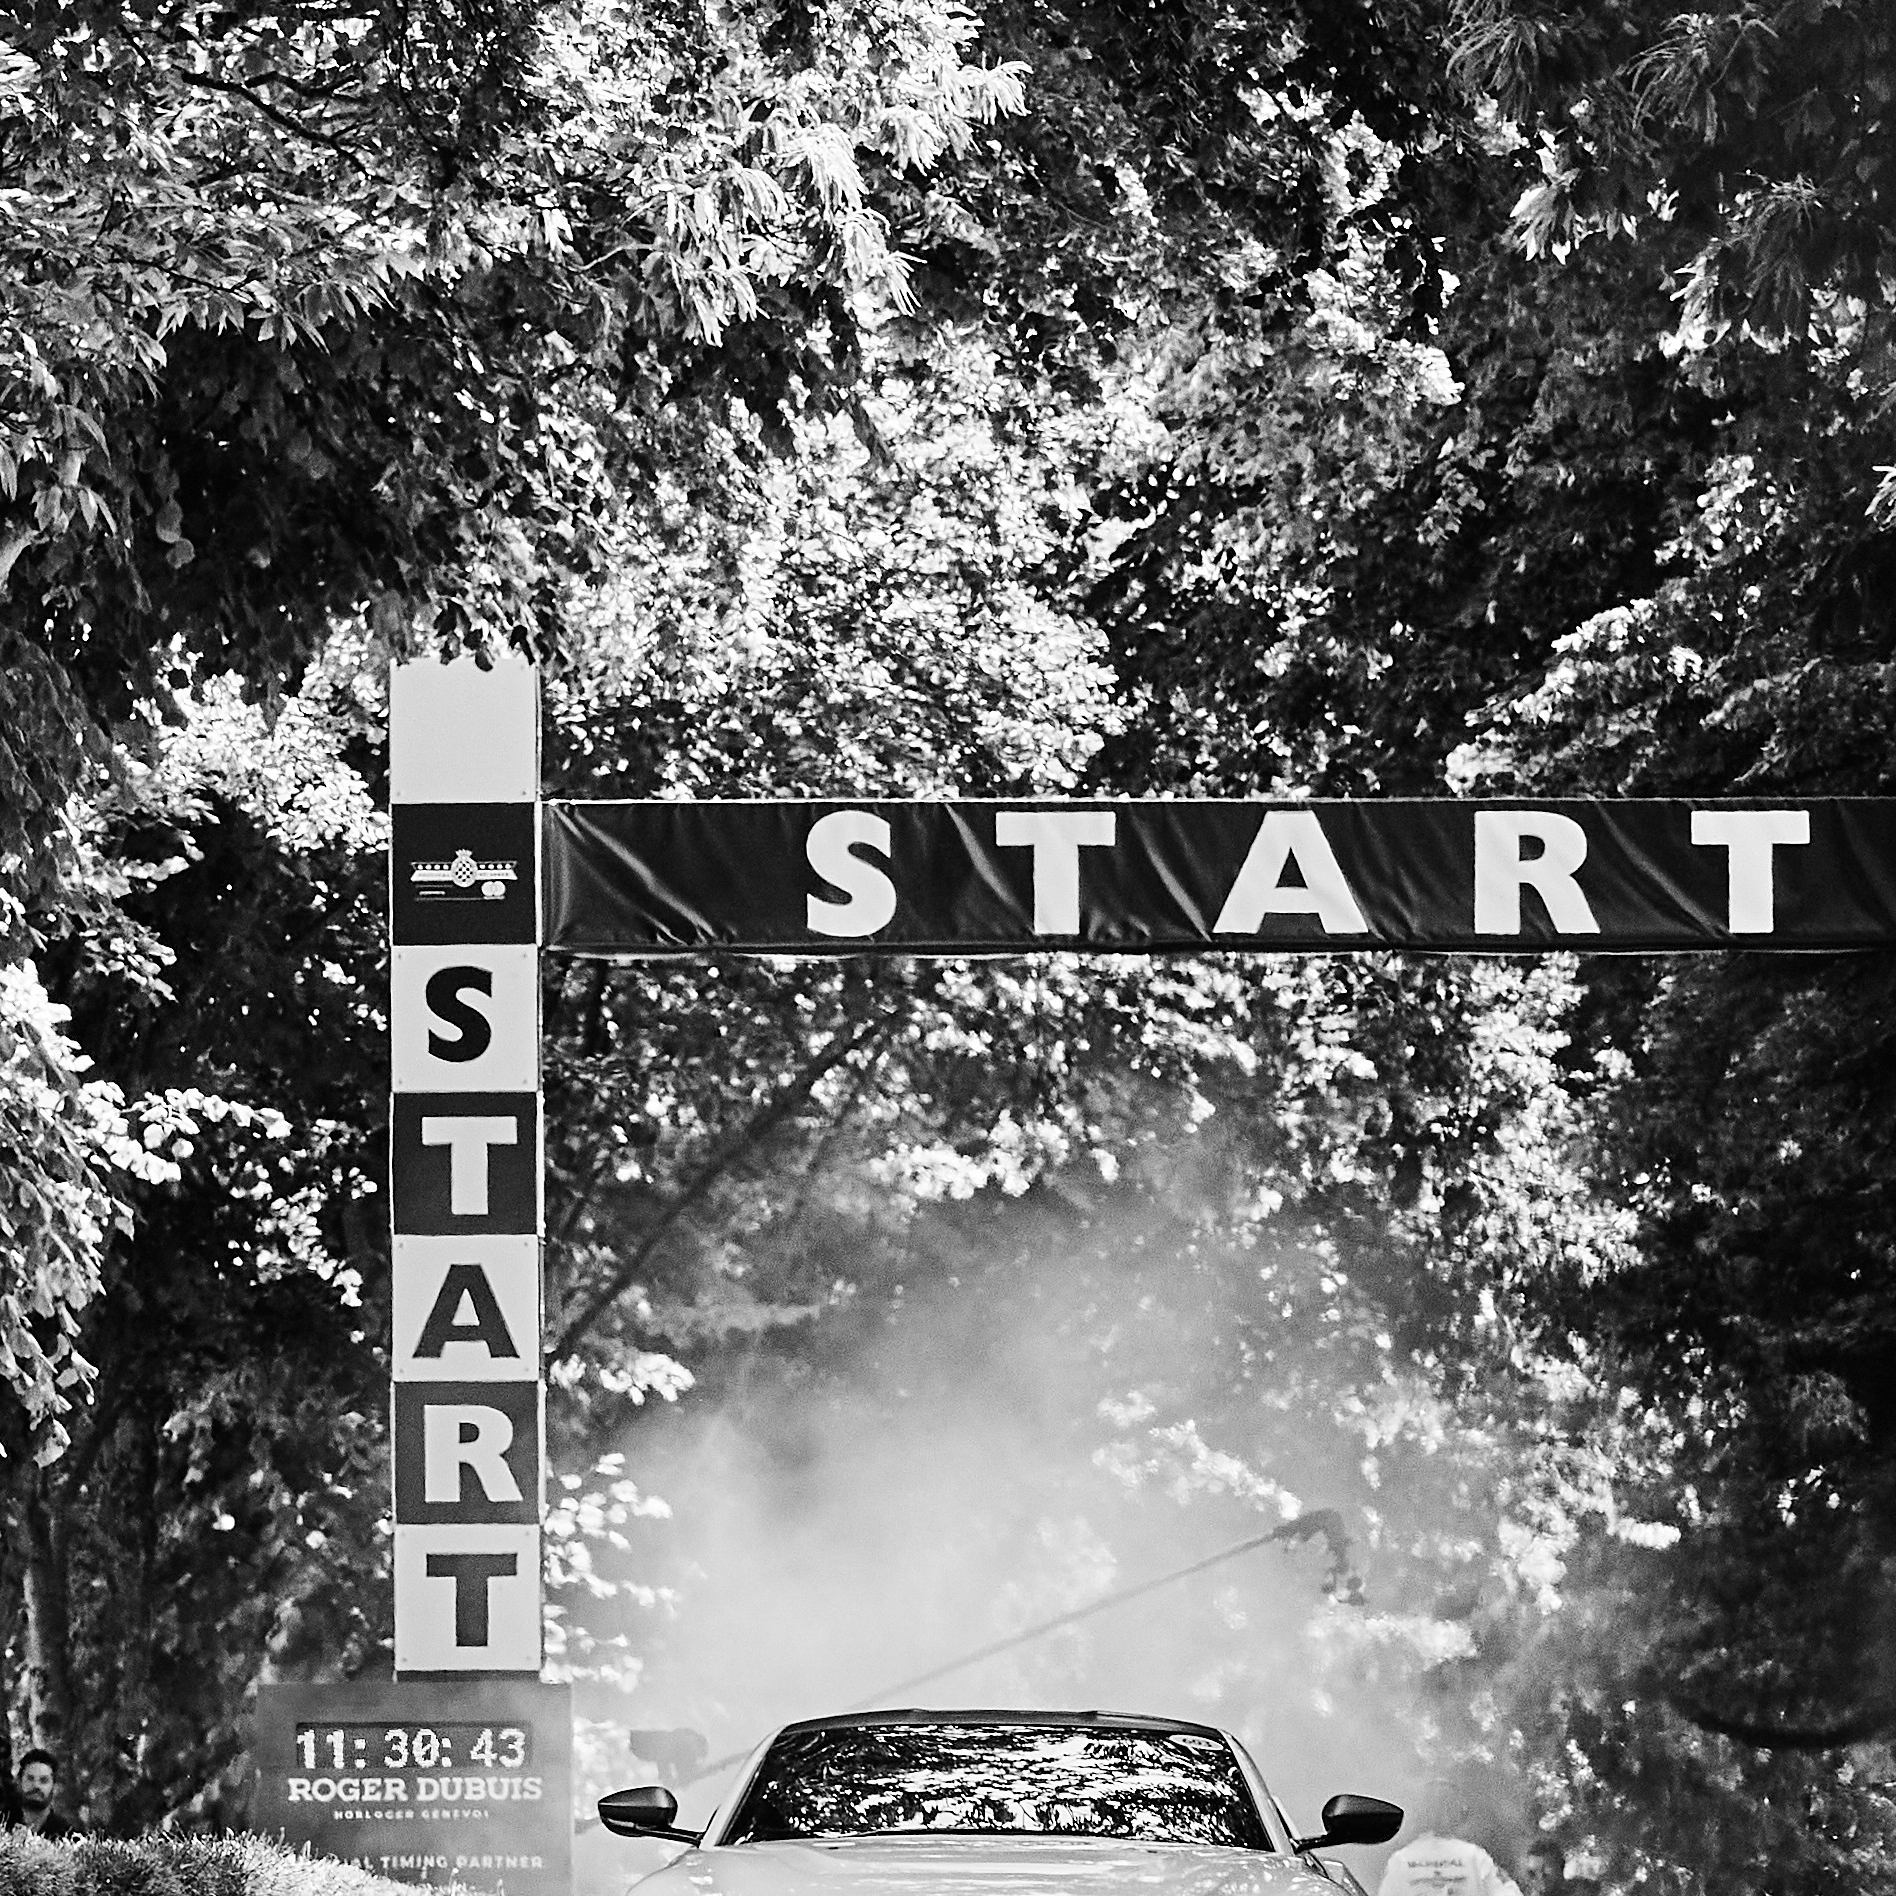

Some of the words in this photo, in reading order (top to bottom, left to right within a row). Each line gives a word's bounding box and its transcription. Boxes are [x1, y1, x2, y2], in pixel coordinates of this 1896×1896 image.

[805, 808, 1812, 938] START
[412, 965, 524, 1649] START
[288, 1777, 408, 1802] ROGER
[416, 1776, 543, 1801] DUBUIS
[421, 1809, 489, 1820] GENEVOI
[380, 1854, 448, 1869] TIMING
[456, 1855, 543, 1869] PARTNER
